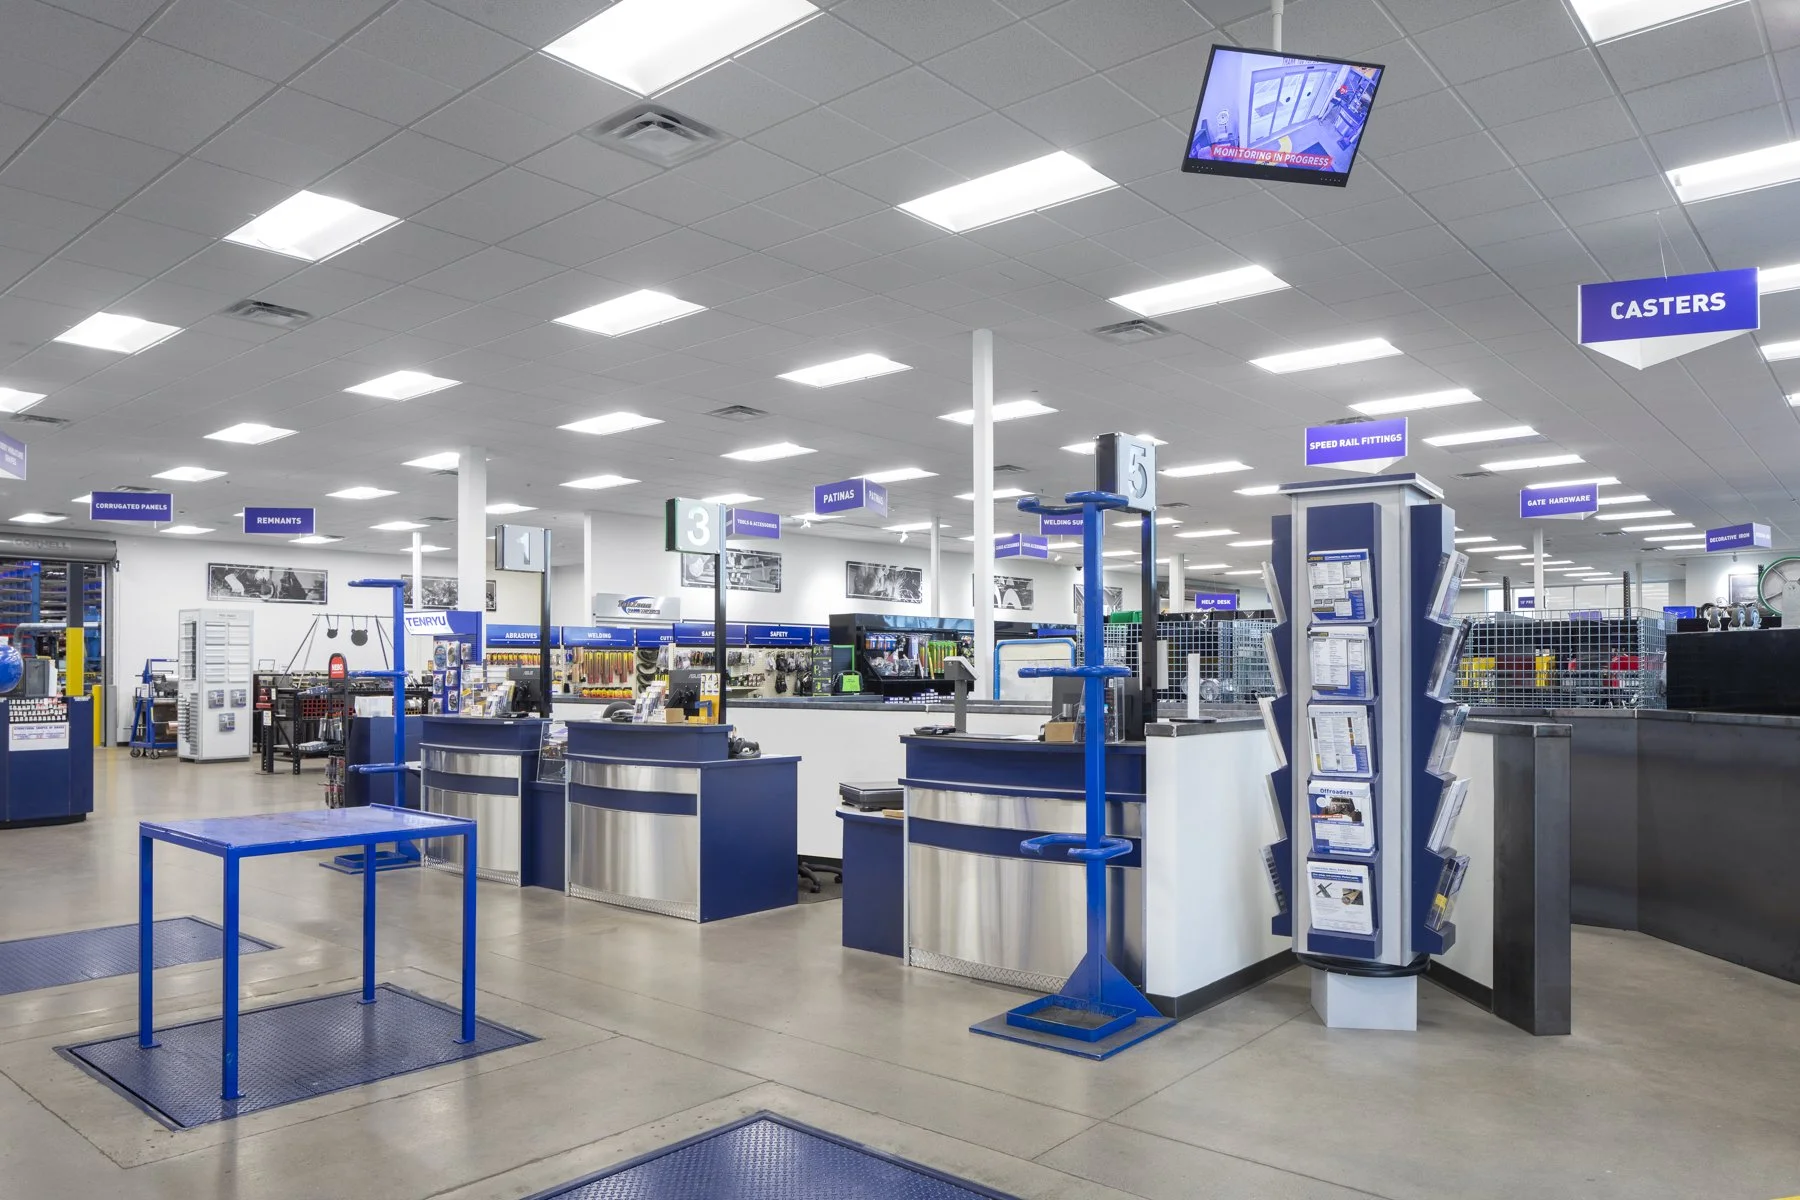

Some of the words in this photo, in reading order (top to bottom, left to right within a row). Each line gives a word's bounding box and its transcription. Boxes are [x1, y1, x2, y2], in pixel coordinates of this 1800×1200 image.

[1213, 146, 1272, 161] MONITORING
[1273, 152, 1283, 161] IN
[1284, 153, 1330, 167] PROGRESS
[1610, 291, 1727, 320] CASTERS
[1309, 440, 1338, 450] SPEED
[1339, 438, 1360, 448] RAIL
[1361, 433, 1402, 445] FITTINGS
[1127, 444, 1148, 499] 5
[823, 489, 855, 504] PATINAS
[1527, 498, 1547, 507] GATE
[1548, 494, 1591, 505] HARDWARE
[95, 502, 140, 510] CORRUGATED
[141, 503, 168, 511] PANELS
[256, 516, 302, 525] REMNANTS
[686, 505, 711, 547] 3
[516, 530, 531, 565] 1
[405, 615, 447, 626] TENRYU
[769, 630, 788, 638] SAFETY
[1320, 787, 1354, 796] Offroaders
